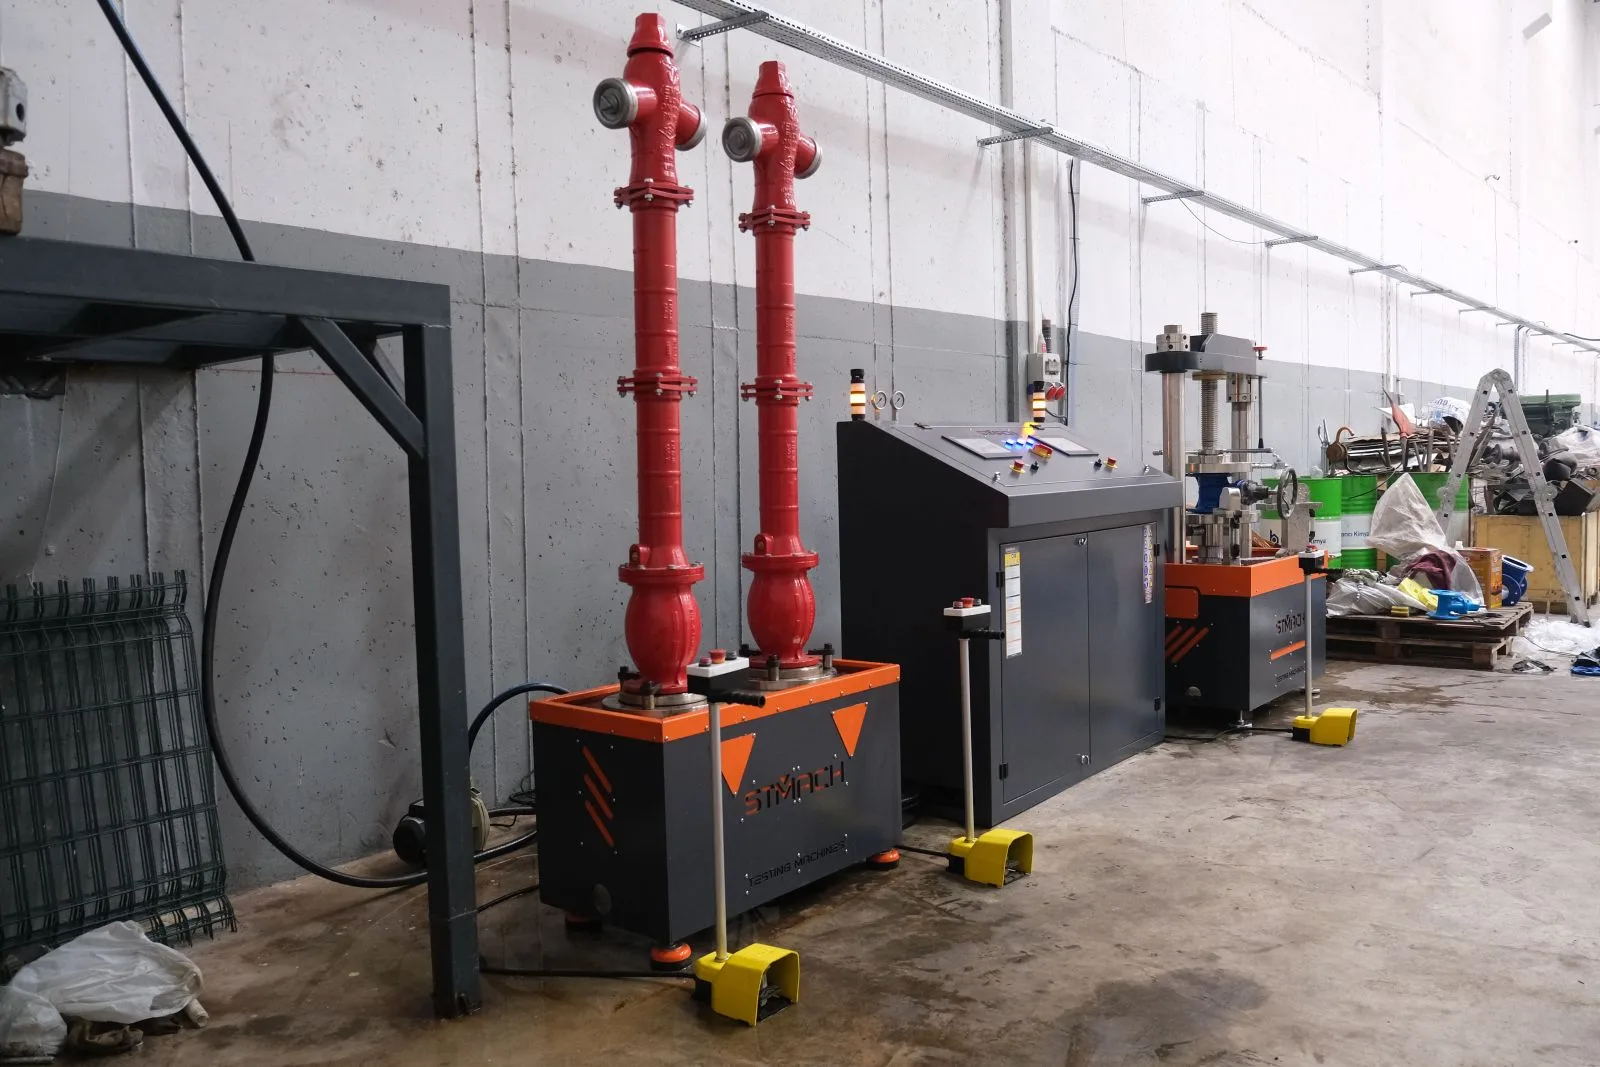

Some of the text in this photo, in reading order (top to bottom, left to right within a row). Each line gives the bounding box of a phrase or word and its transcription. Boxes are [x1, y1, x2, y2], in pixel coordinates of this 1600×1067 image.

[744, 761, 845, 816] STMACH
[748, 840, 846, 887] TESTING MACHINES
